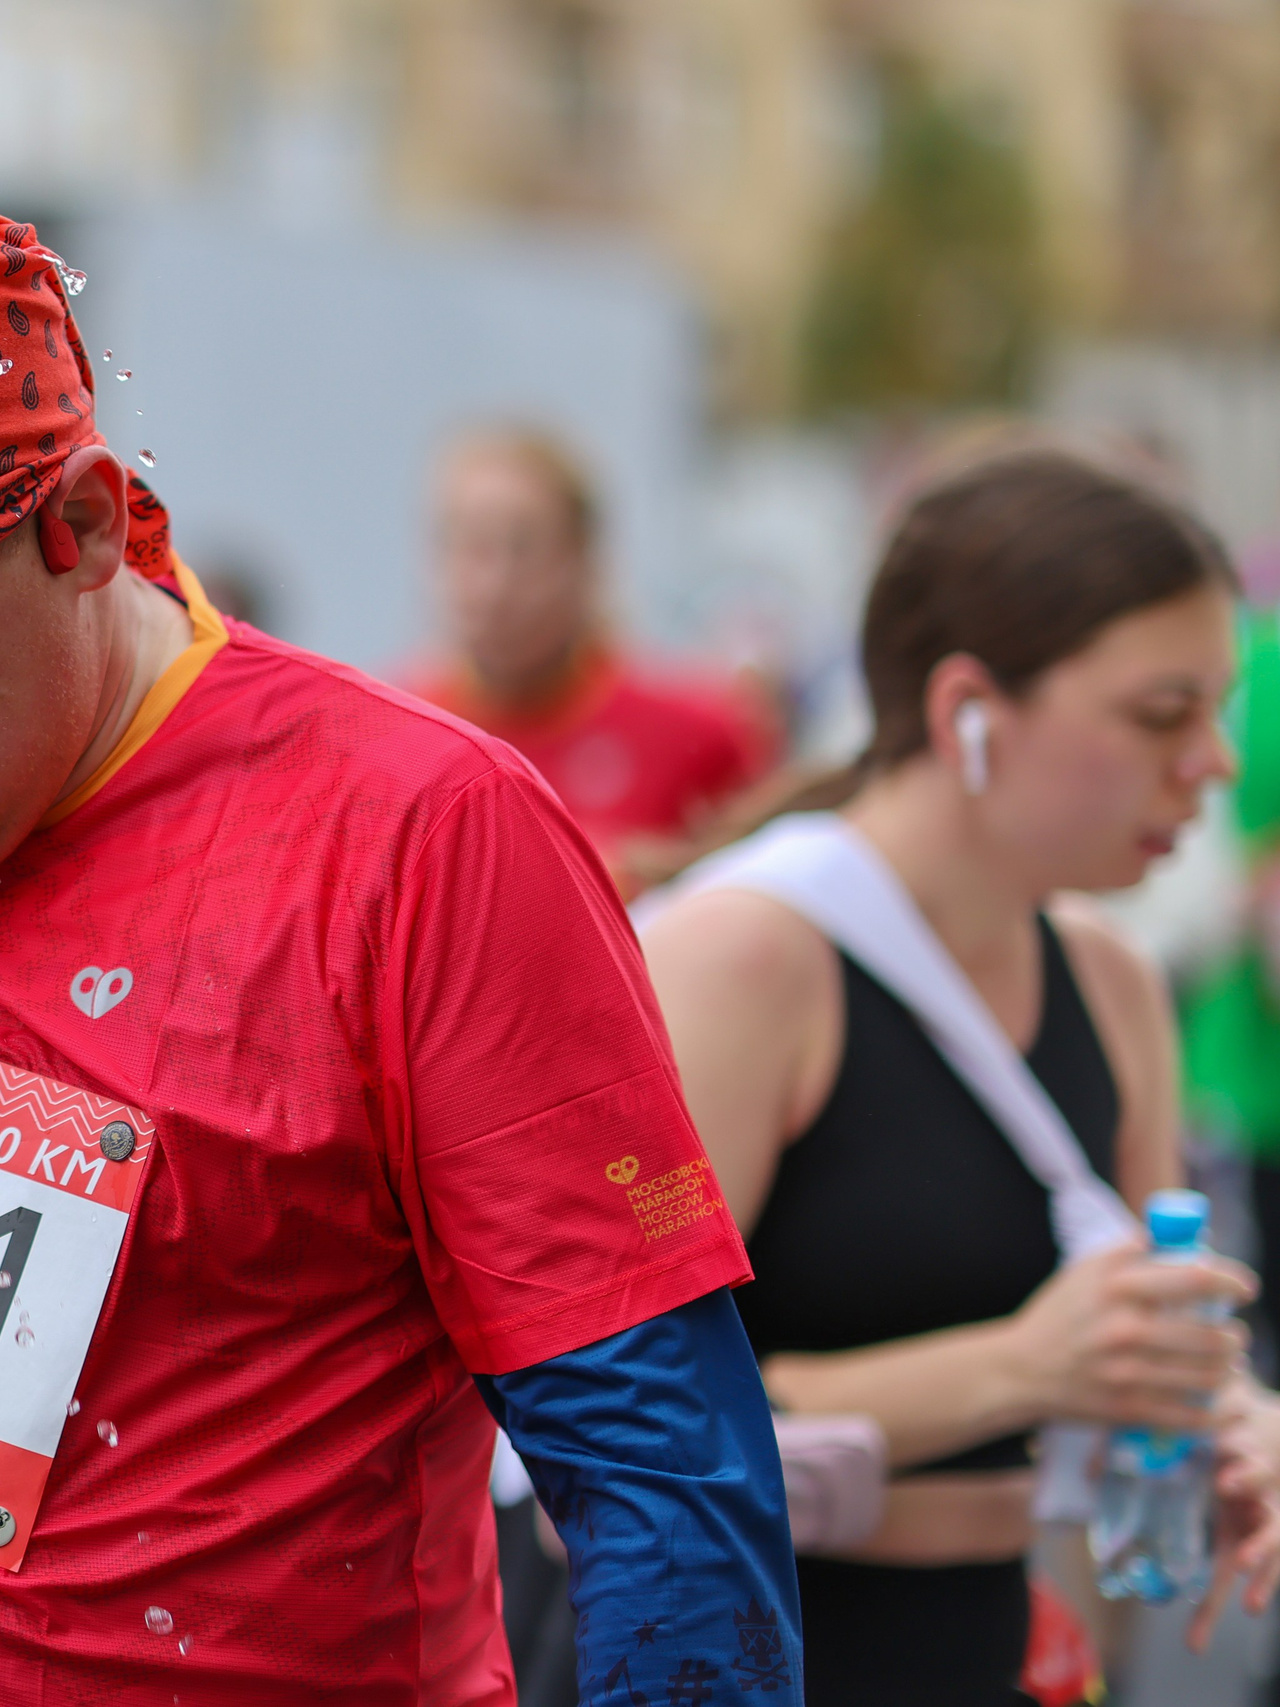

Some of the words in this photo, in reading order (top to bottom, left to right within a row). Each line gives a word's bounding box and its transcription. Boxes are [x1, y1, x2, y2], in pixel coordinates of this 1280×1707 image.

[632, 1174, 707, 1216] МАРАФОН
[639, 1190, 704, 1230] MOSCOW
[644, 1197, 723, 1243] MARATHON
